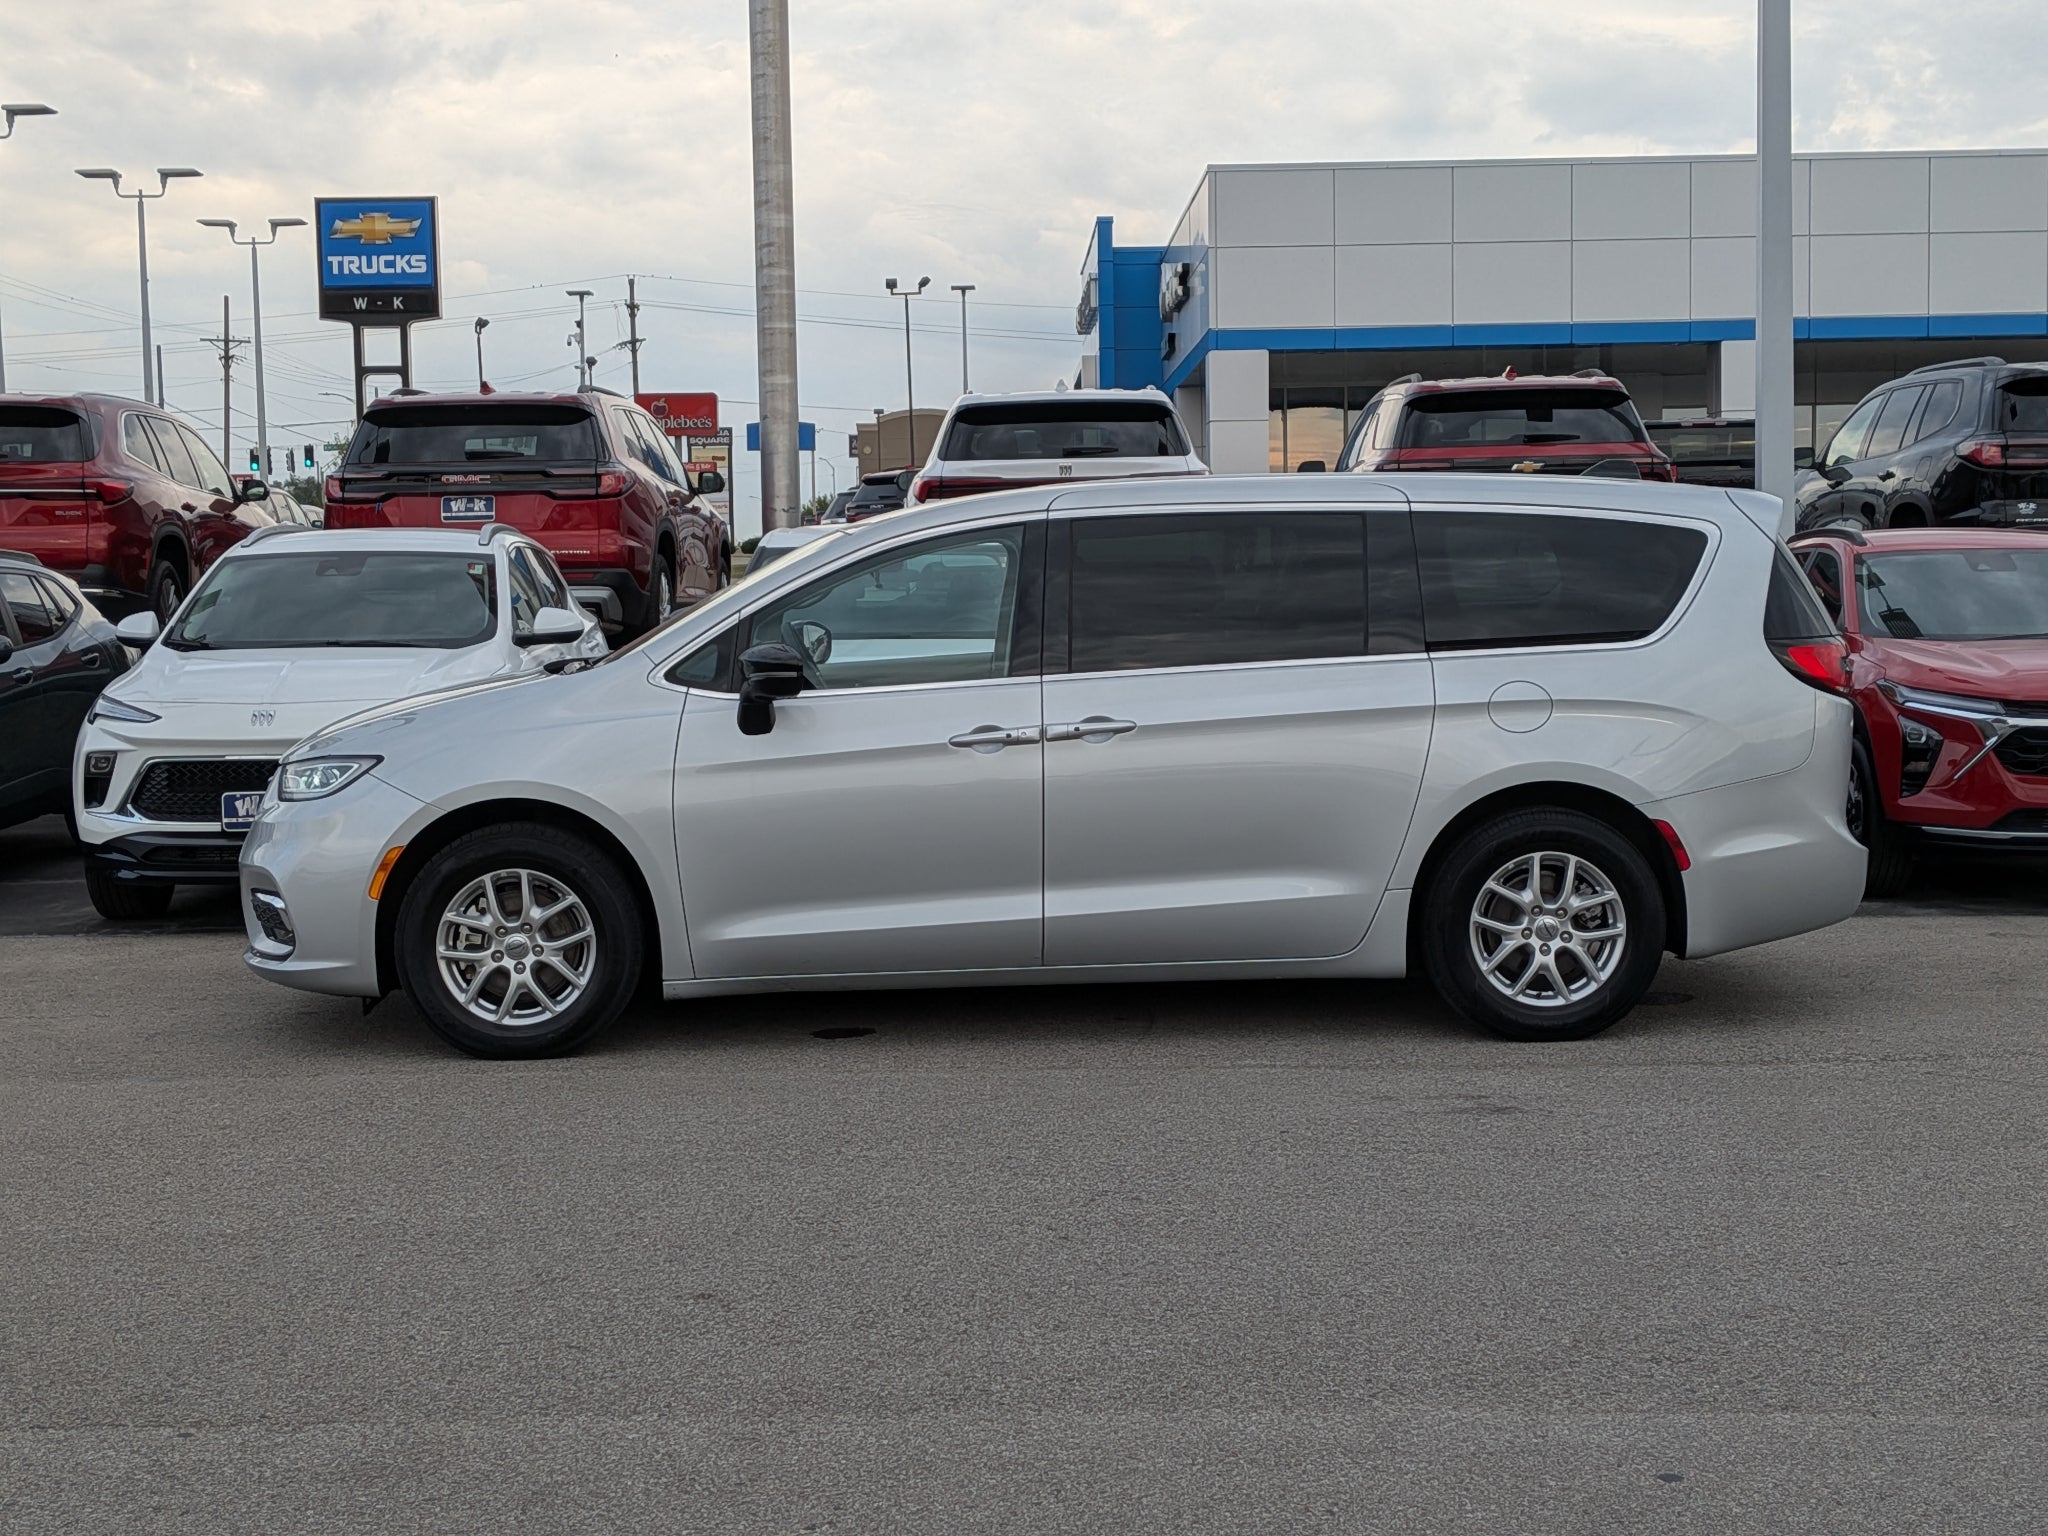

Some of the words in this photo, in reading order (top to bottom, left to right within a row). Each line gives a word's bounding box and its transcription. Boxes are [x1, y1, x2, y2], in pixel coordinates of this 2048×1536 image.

[327, 254, 427, 275] TRUCKS
[656, 415, 713, 432] plebee's
[689, 436, 730, 445] SQUARE
[441, 474, 491, 484] GMC
[450, 497, 487, 512] W-K
